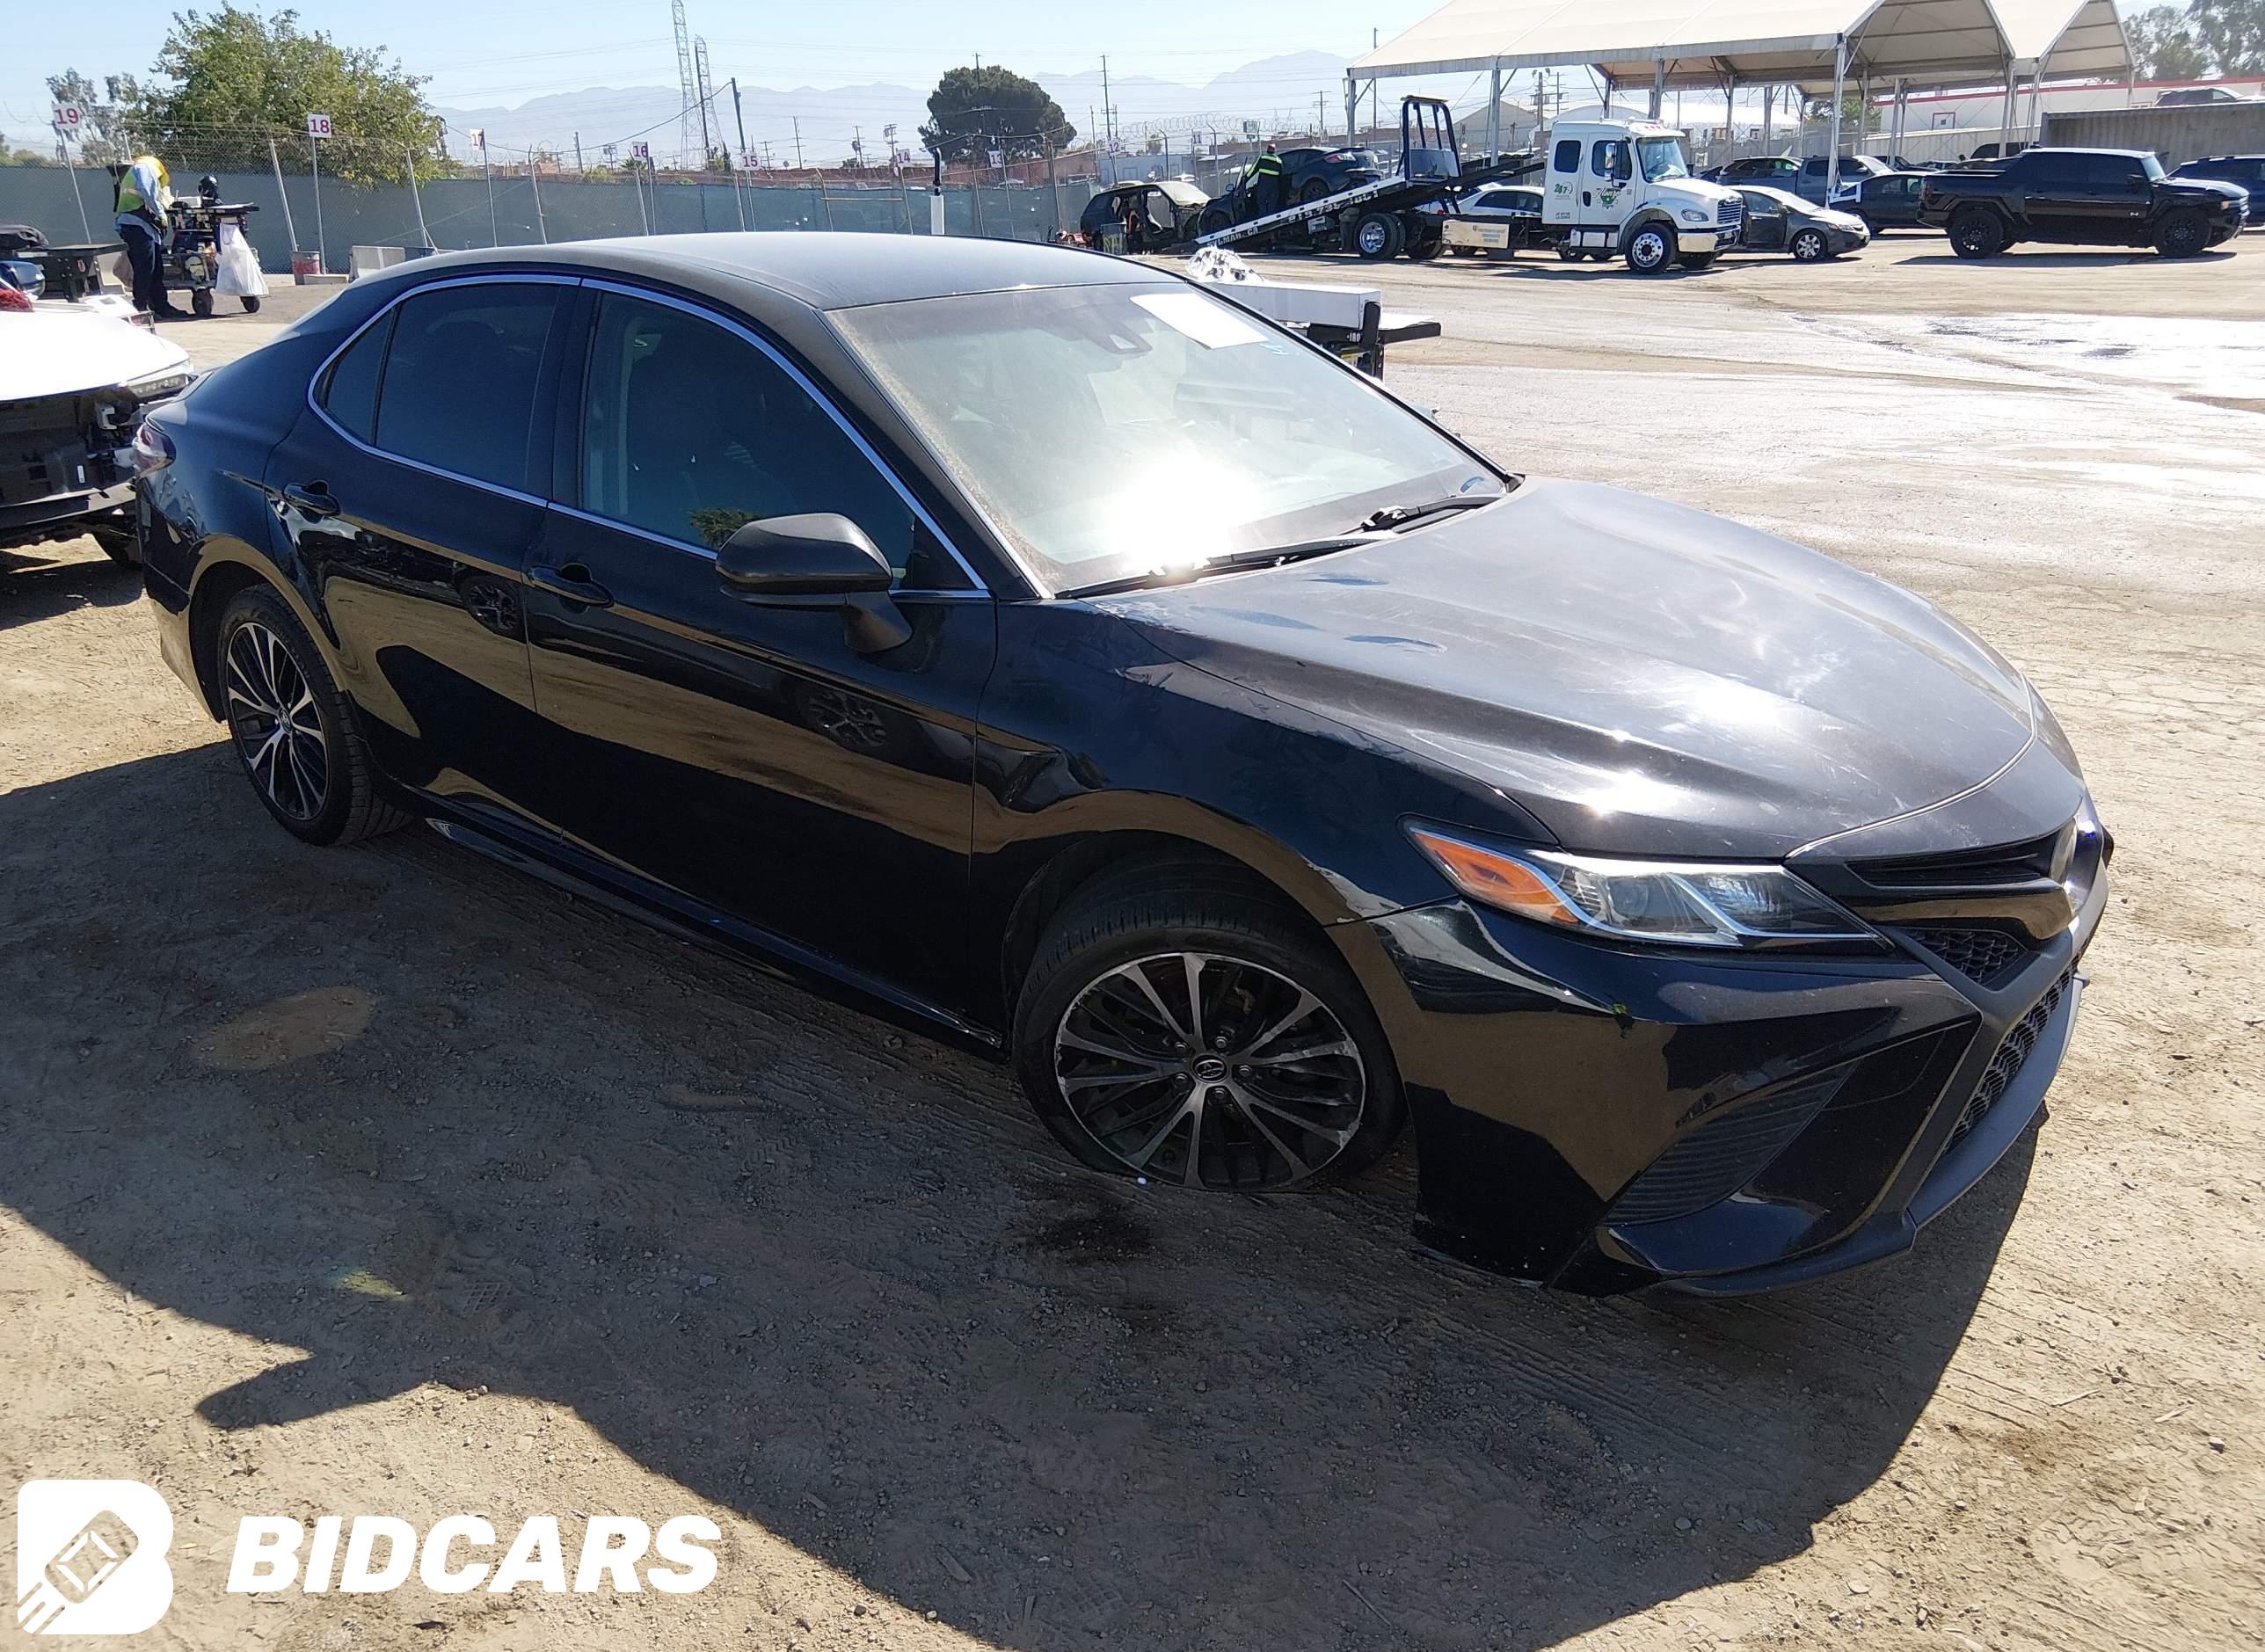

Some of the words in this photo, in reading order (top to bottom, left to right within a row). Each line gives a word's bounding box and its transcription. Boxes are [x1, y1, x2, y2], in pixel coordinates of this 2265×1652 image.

[54, 108, 78, 124] 19
[310, 119, 330, 134] 18
[633, 145, 648, 158] 16
[1109, 142, 1120, 153] 12
[743, 155, 758, 167] 15
[897, 151, 910, 164] 14
